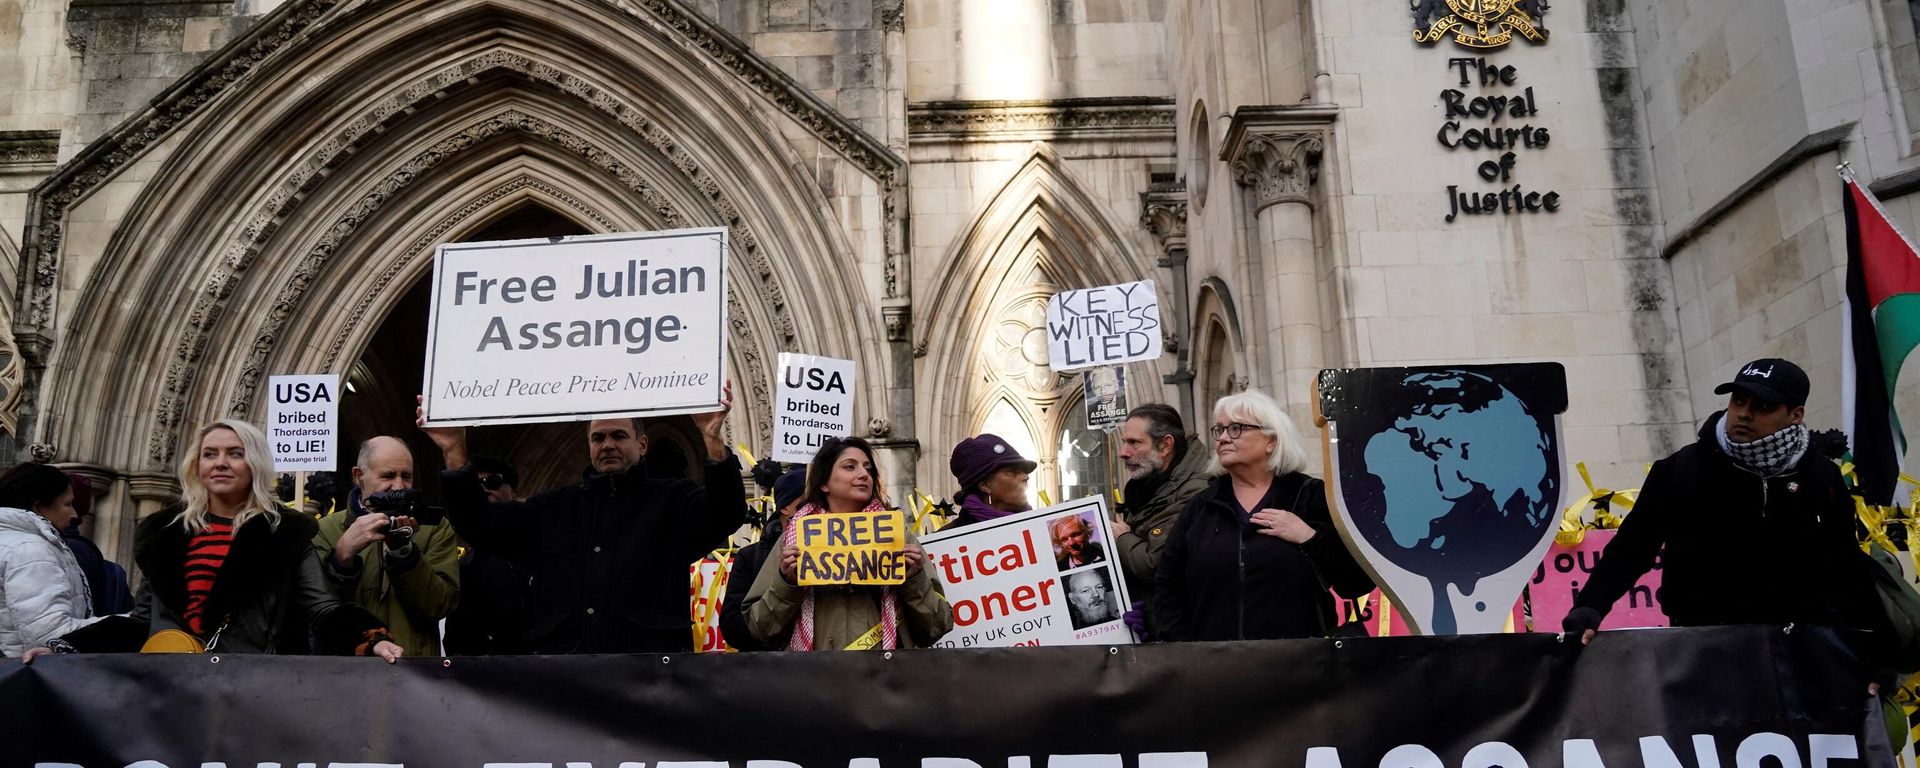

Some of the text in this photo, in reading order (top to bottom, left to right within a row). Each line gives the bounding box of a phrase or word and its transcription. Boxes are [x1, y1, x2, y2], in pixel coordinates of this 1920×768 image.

[1505, 16, 1539, 40] DROIT
[1448, 57, 1518, 87] The
[1440, 86, 1538, 123] Royal
[1437, 120, 1550, 152] Courts
[1477, 151, 1517, 183] of
[1444, 184, 1560, 223] Justice
[454, 259, 706, 306] Free Julian
[1058, 282, 1140, 321] KEY
[476, 314, 681, 355] Assange
[1049, 303, 1158, 342] WITNESS
[1064, 331, 1150, 366] LIED
[276, 382, 331, 404] USA
[443, 370, 709, 400] Nobel Peace Prize Nominee
[785, 366, 846, 395] USA
[278, 410, 326, 424] bribed
[787, 398, 840, 416] bribed
[1090, 408, 1126, 418] ASSANGE
[274, 428, 330, 436] Thordarson
[780, 416, 844, 432] Thordarson
[784, 432, 800, 446] to
[276, 440, 326, 454] to LIE!
[283, 456, 312, 464] Assange
[803, 514, 895, 546] FREE
[800, 550, 904, 581] ASSANGE
[953, 578, 1055, 627] oner
[962, 633, 980, 648] BY
[986, 627, 1007, 642] UK
[1012, 614, 1052, 634] GOVT
